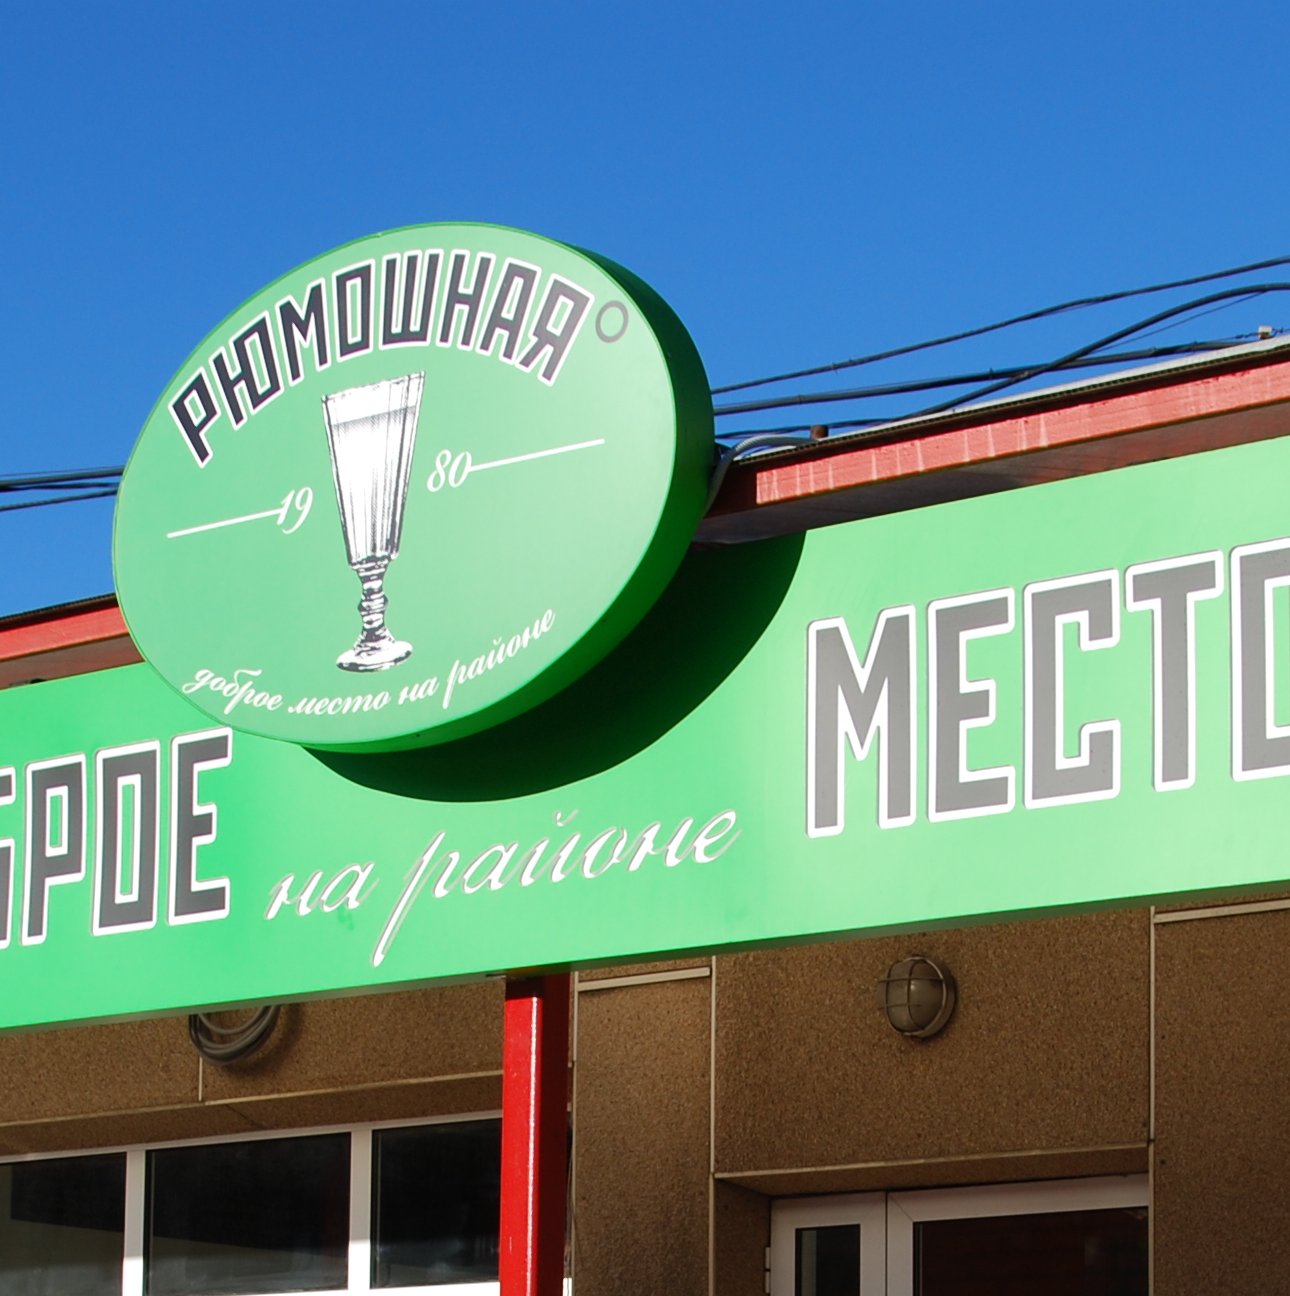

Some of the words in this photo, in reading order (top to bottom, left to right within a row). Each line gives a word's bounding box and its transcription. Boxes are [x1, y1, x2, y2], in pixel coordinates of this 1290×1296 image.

[168, 248, 595, 469] РЮМОШНАЯ
[276, 486, 314, 535] 19
[426, 449, 472, 493] 80
[182, 668, 284, 715] доброе
[287, 690, 391, 717] место
[398, 676, 441, 704] на
[441, 608, 557, 710] районе
[263, 861, 381, 921] на
[369, 808, 743, 969] районе
